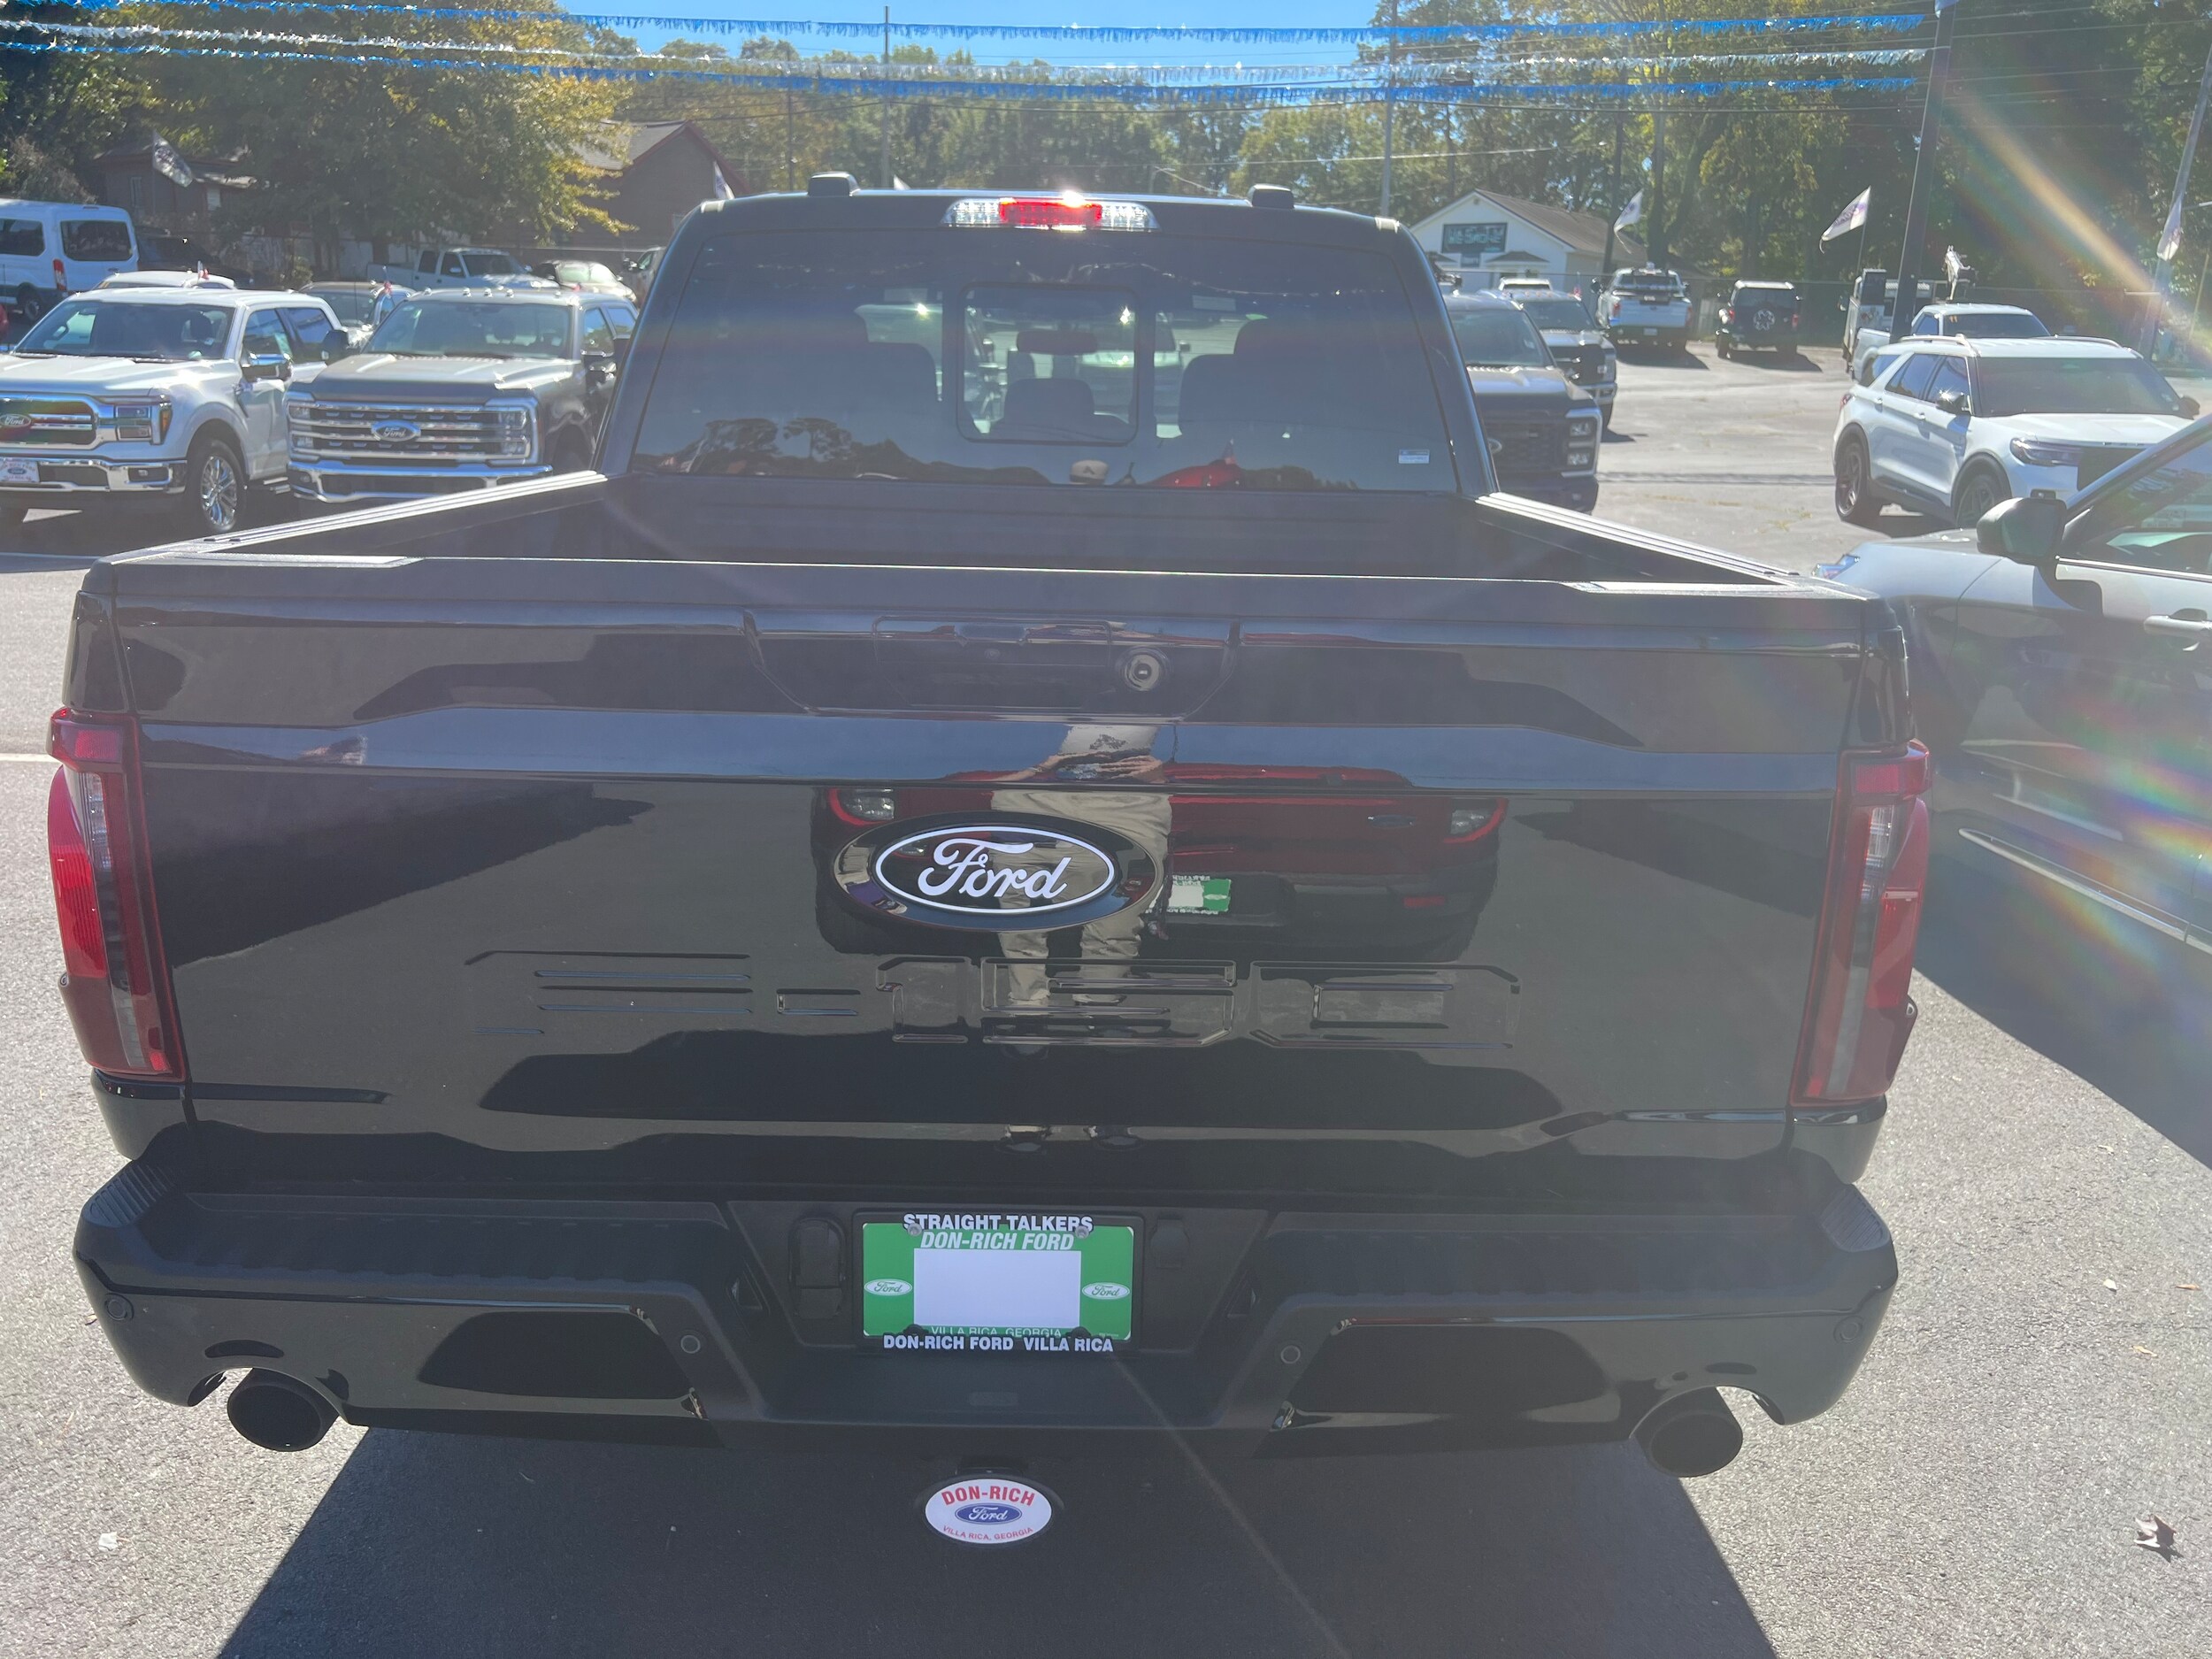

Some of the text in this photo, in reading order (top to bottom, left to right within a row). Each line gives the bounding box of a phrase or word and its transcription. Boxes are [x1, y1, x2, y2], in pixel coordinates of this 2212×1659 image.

[918, 838, 1072, 899] Ford
[903, 1213, 1094, 1233] STRAIGHT TALKERS
[920, 1232, 1075, 1251] DON-RICH FORD
[873, 1281, 903, 1293] Ford
[1091, 1285, 1121, 1296] Ford
[1005, 1327, 1062, 1337] GEORGIA
[883, 1334, 1114, 1353] DON-RICH FORD VILLA RICA
[941, 1486, 1035, 1506] DON-RICH
[968, 1506, 1008, 1520] Ford
[943, 1525, 966, 1538] VILLA
[994, 1527, 1033, 1540] GEORGIA
